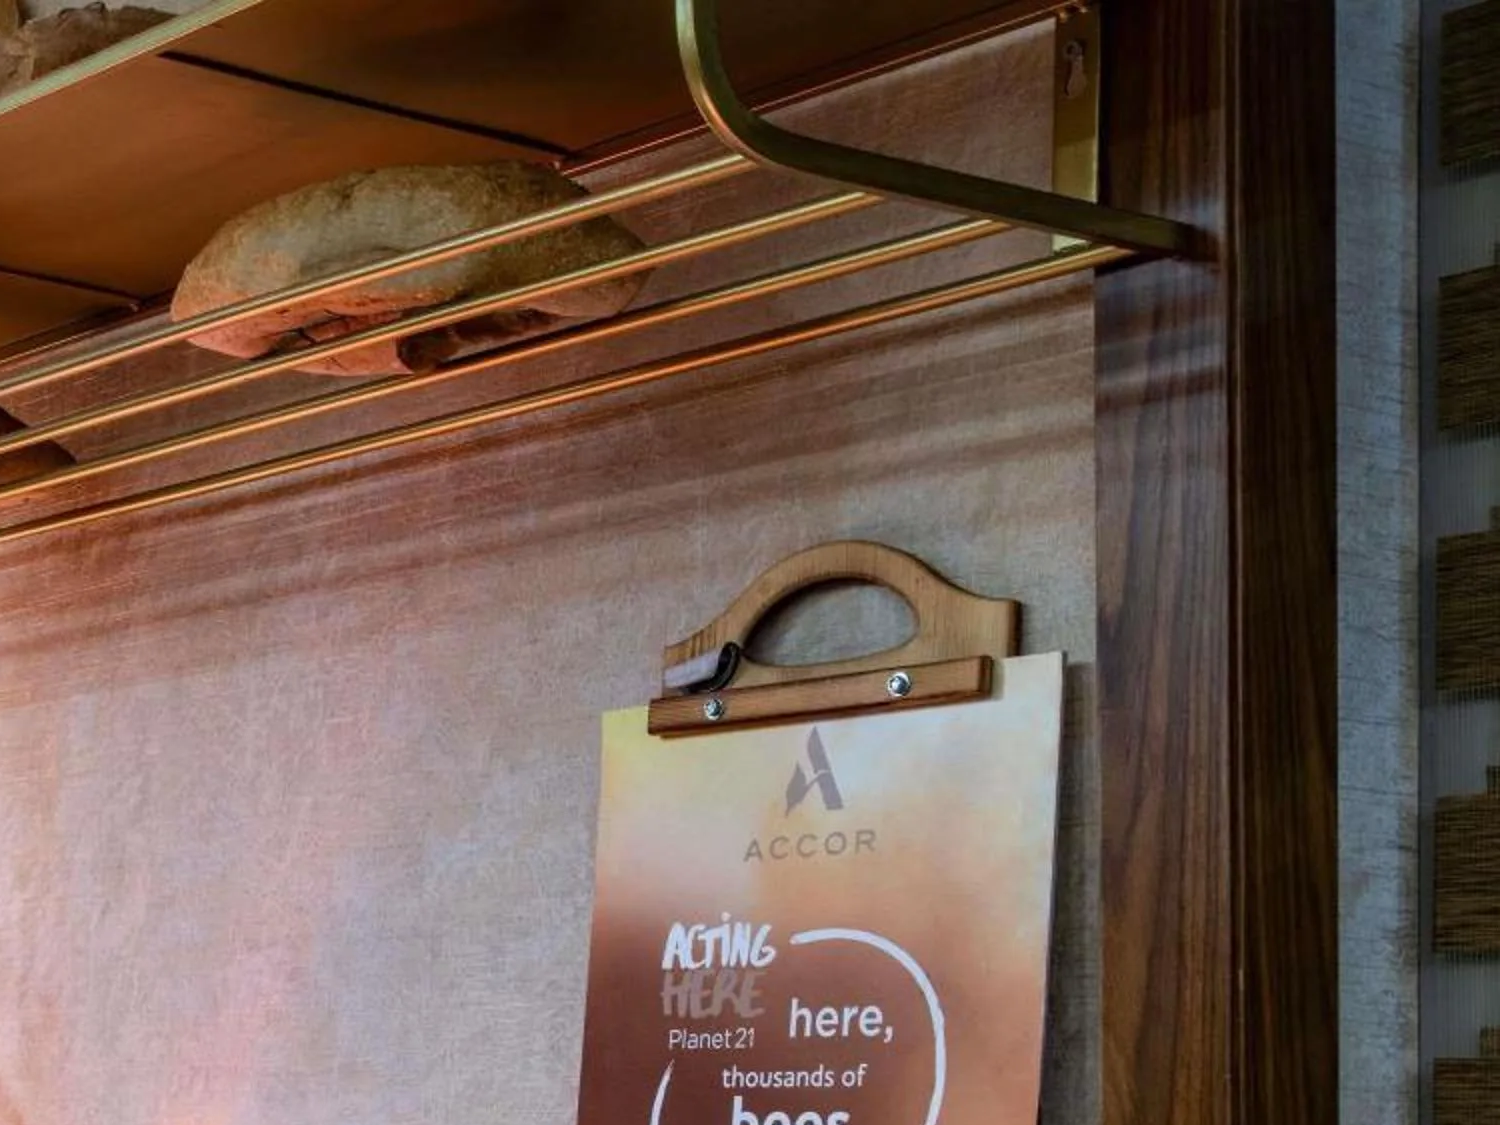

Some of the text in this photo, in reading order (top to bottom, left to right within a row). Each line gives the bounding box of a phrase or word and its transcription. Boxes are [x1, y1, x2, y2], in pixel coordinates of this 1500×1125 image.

[743, 829, 876, 862] ACCOR
[660, 970, 766, 1018] HERE
[789, 998, 893, 1042] here,
[668, 1027, 755, 1049] Planet 21
[722, 1063, 868, 1088] thousands of
